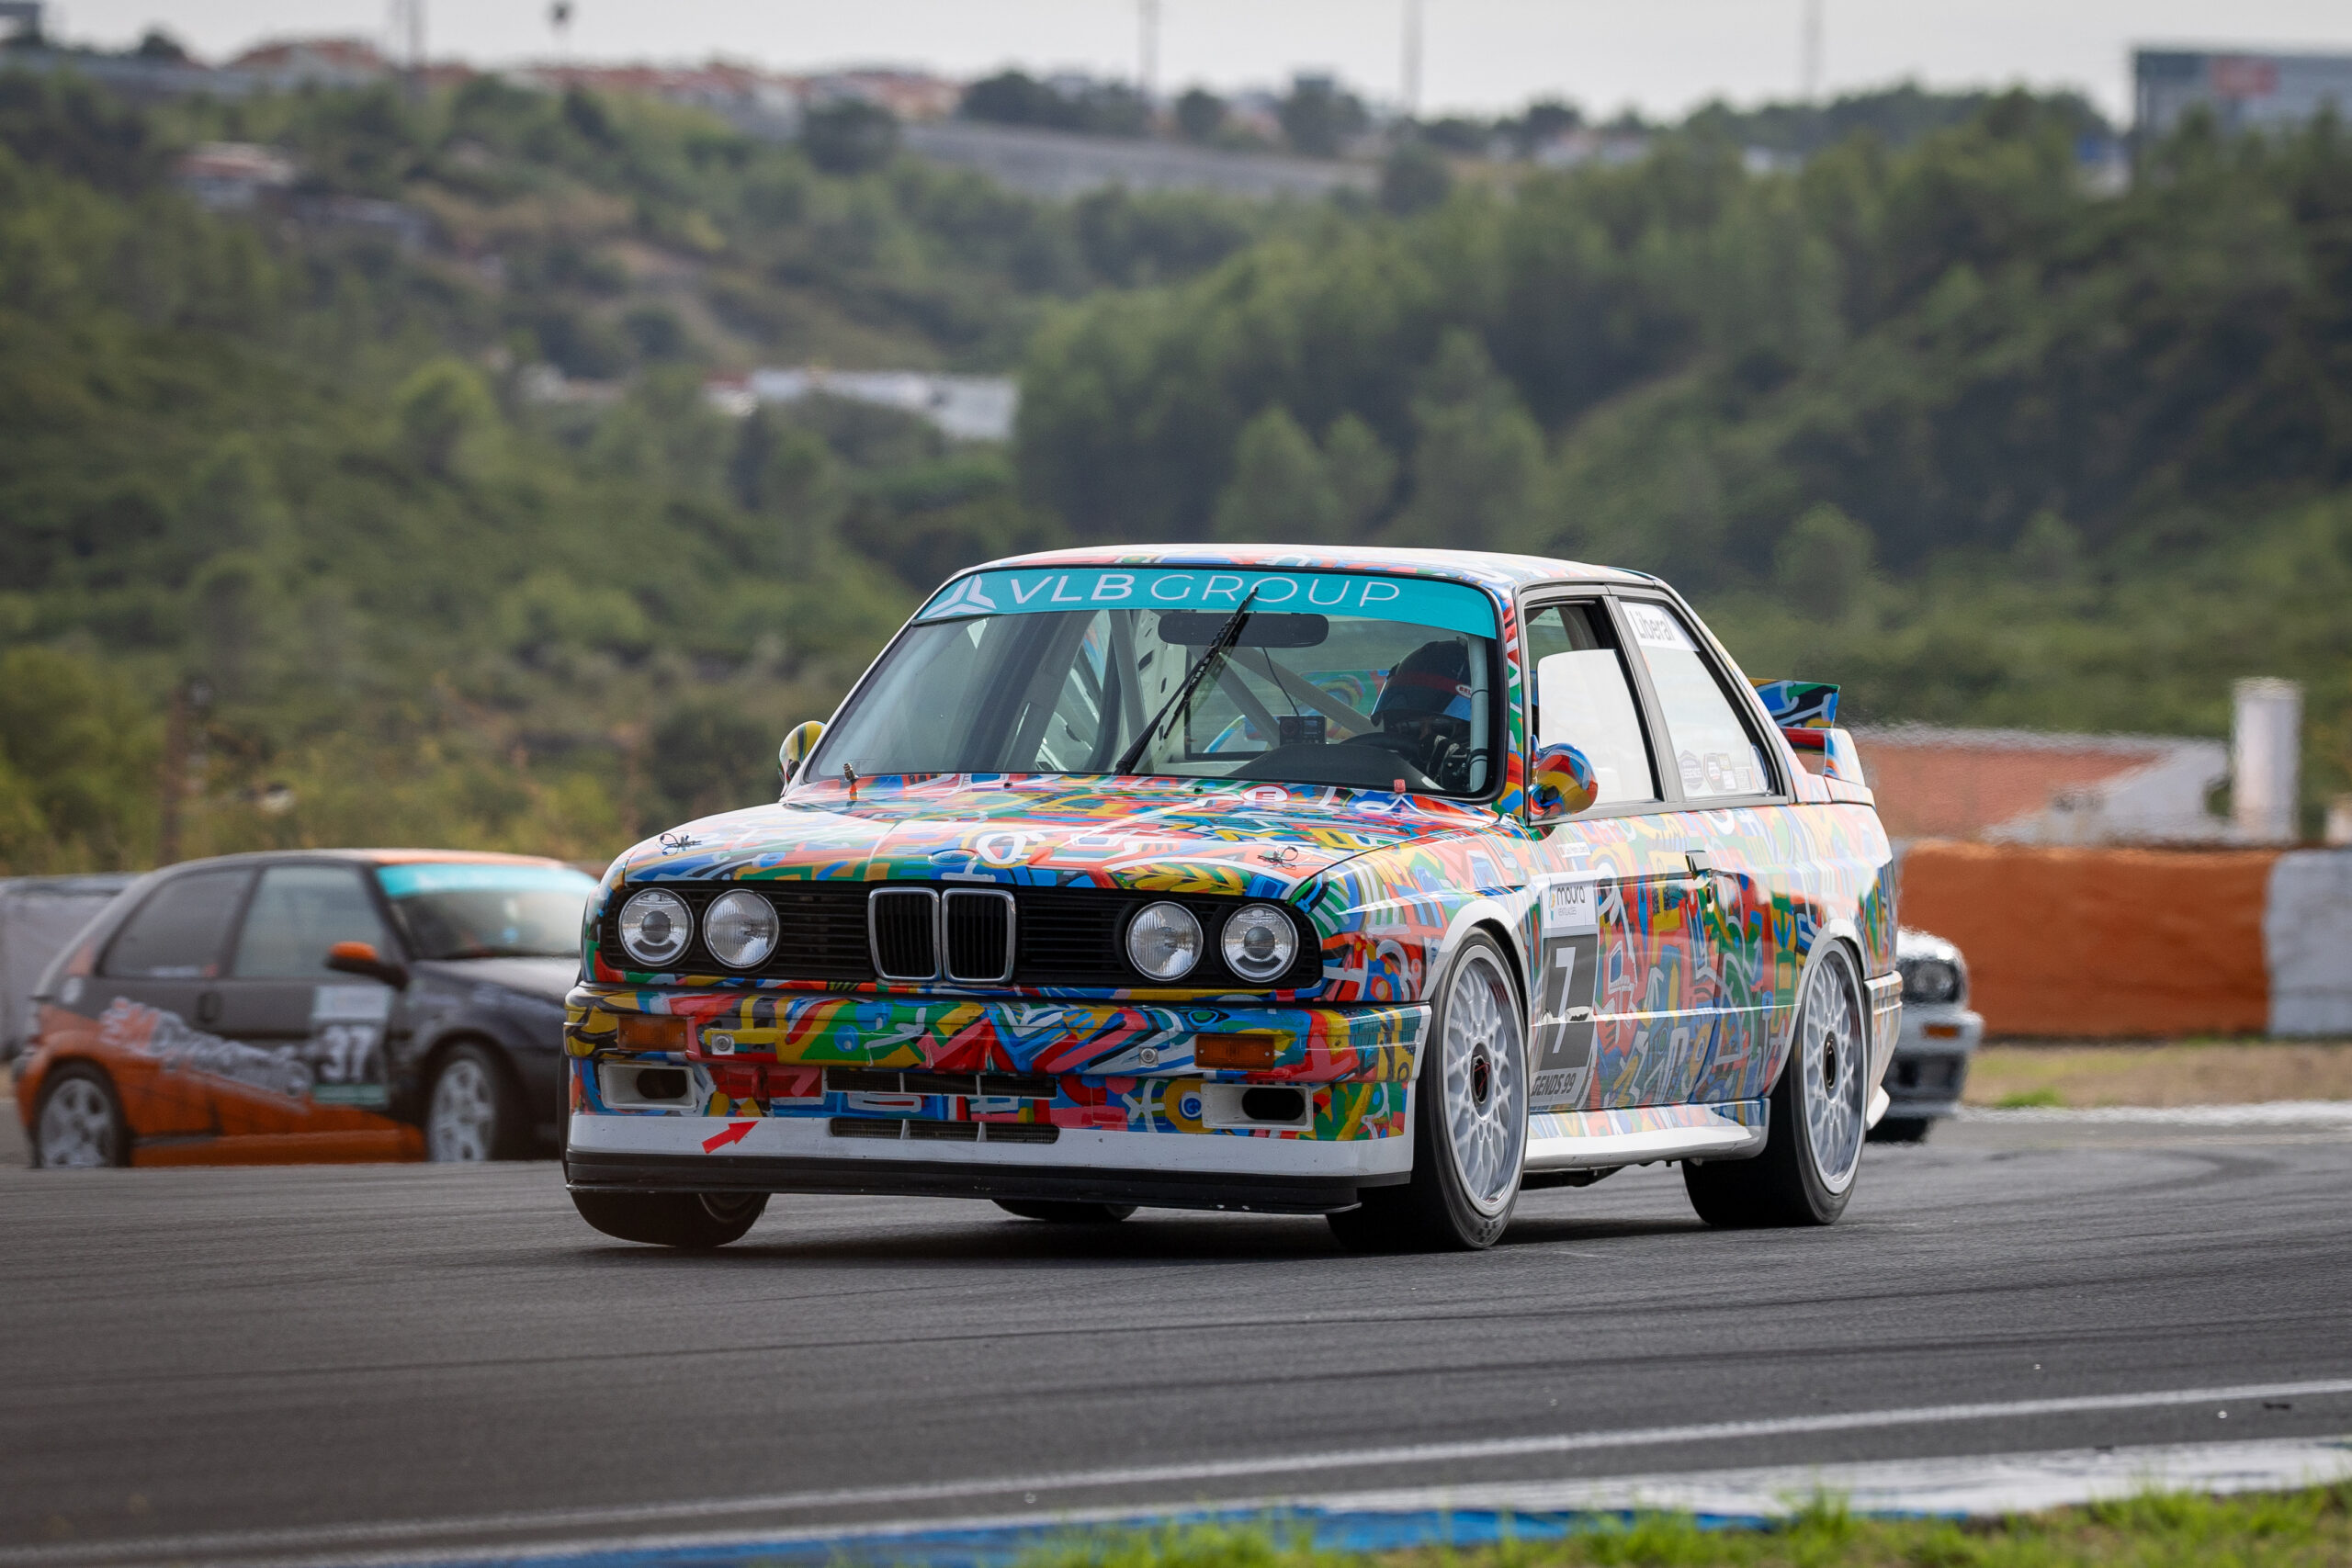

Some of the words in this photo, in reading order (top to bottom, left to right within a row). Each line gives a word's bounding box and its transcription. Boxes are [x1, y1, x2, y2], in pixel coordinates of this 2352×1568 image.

[1011, 574, 1135, 604] VLB
[1150, 574, 1400, 607] GROUP
[1629, 610, 1676, 640] Liberal
[1556, 886, 1585, 906] moura
[1552, 947, 1577, 1054] 7
[321, 1024, 375, 1081] 37
[1530, 1073, 1566, 1097] GENDS
[1561, 1072, 1577, 1094] 99
